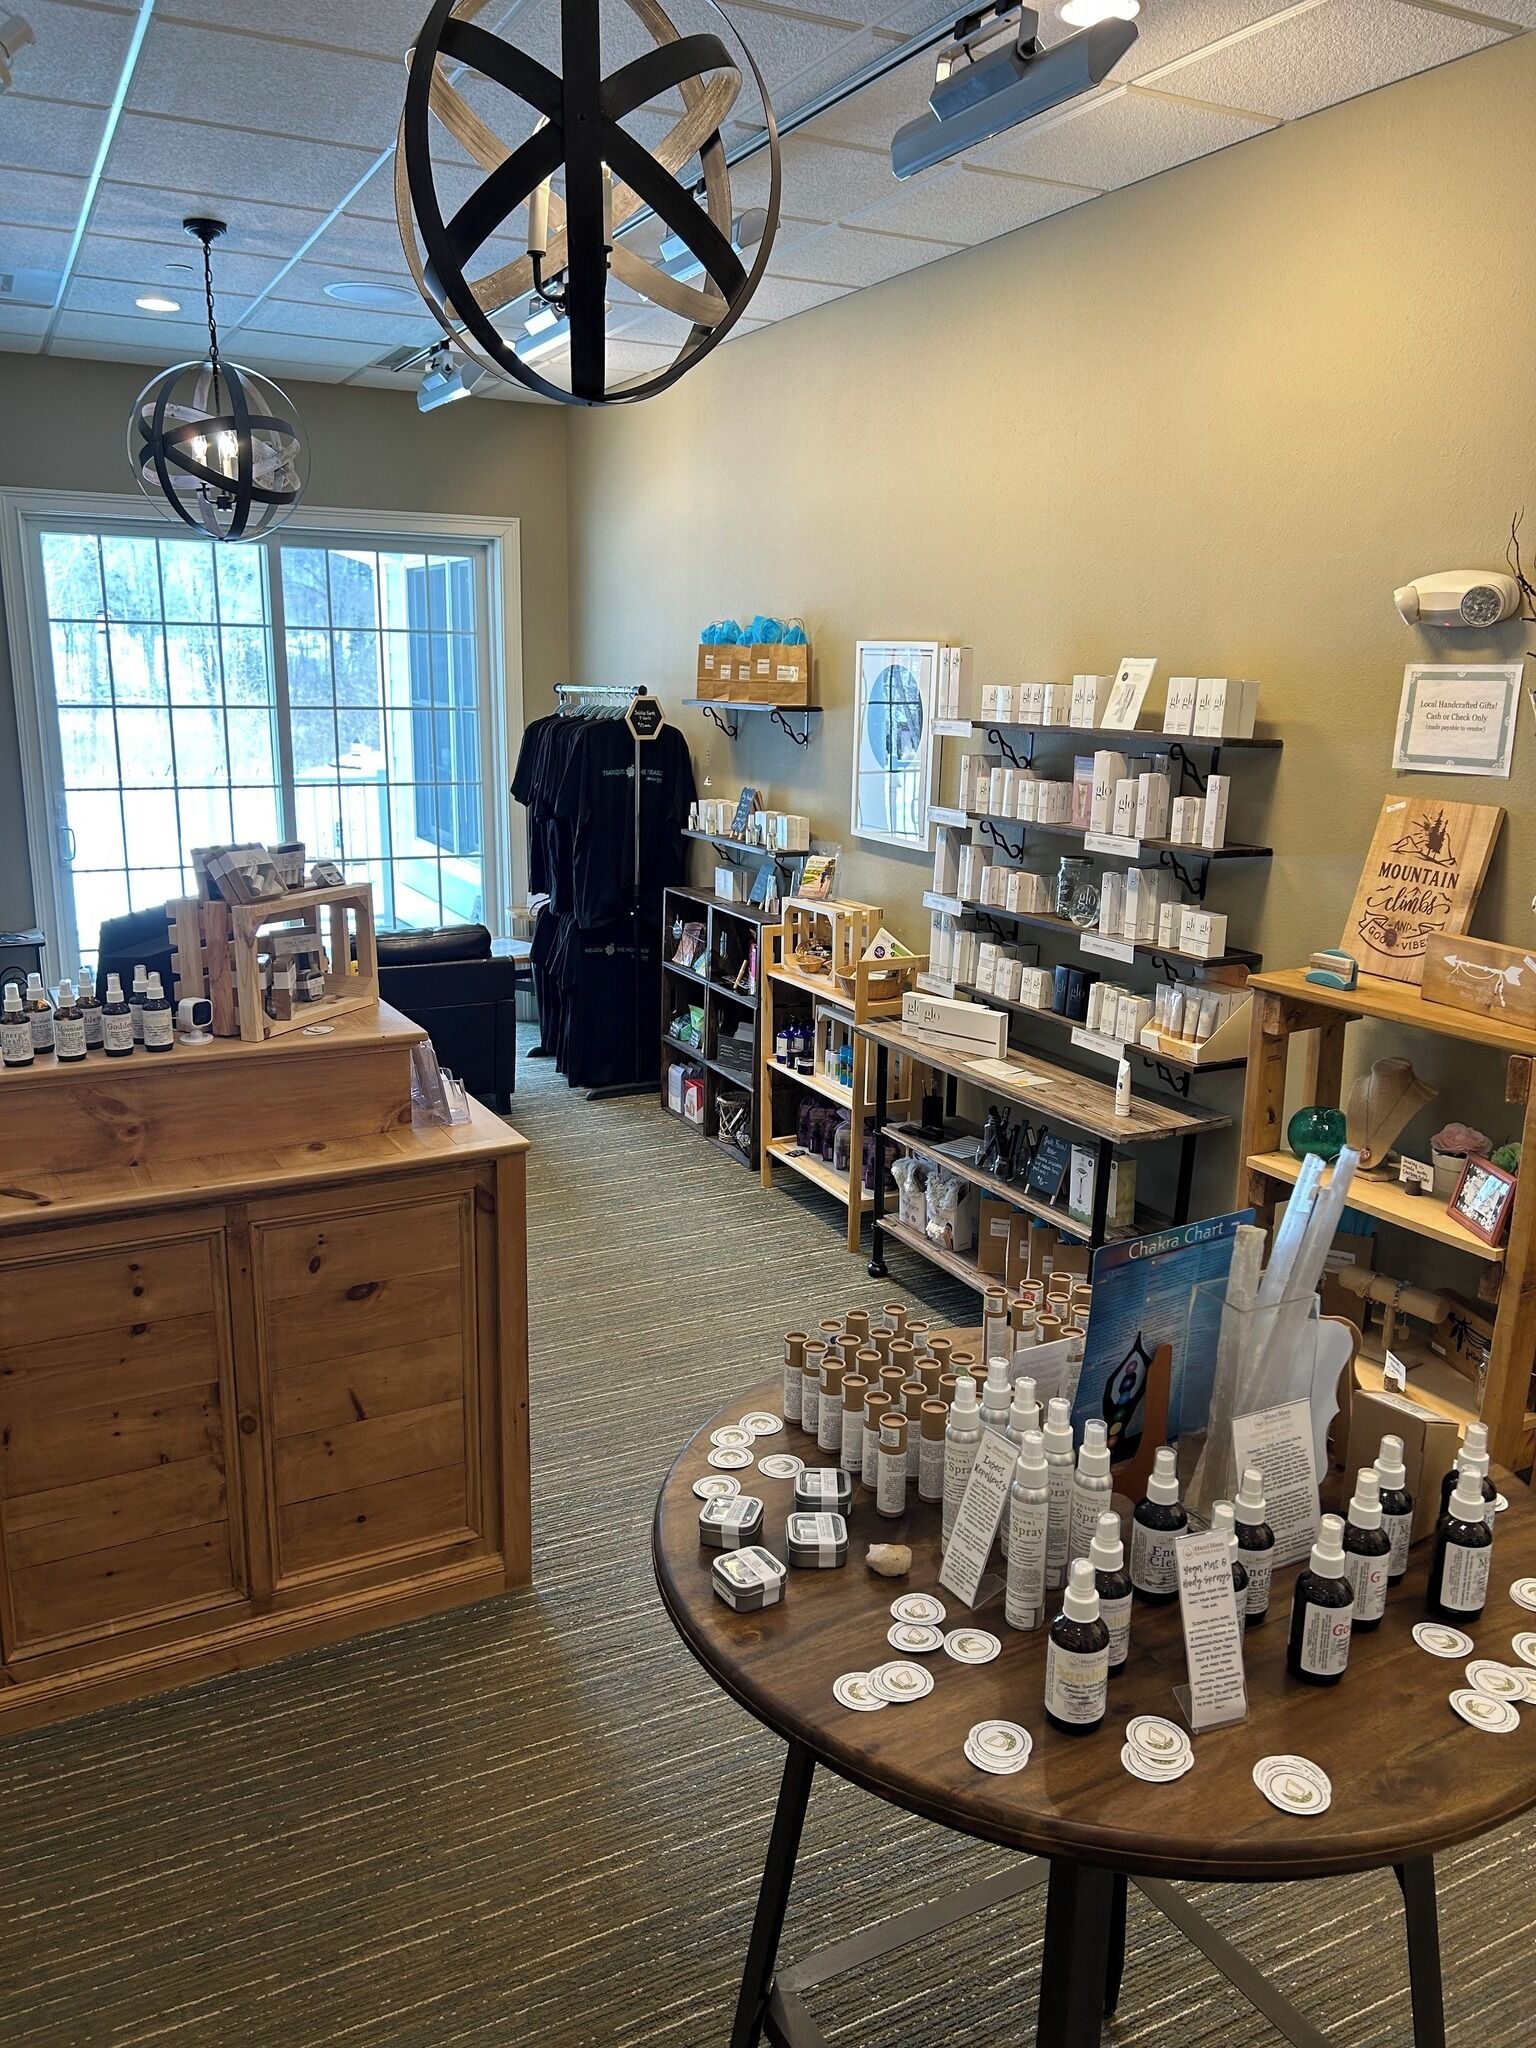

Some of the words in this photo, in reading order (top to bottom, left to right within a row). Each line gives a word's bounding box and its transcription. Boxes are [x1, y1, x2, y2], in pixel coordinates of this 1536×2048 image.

[1420, 700, 1437, 709] Local
[1438, 700, 1478, 710] Handcrafted
[1479, 701, 1498, 710] Gifts!
[1451, 713, 1470, 721] Check
[1472, 714, 1488, 723] Only
[1096, 781, 1112, 800] glo
[1118, 794, 1135, 814] glo
[1378, 862, 1460, 889] MOUNTAIN
[1377, 887, 1445, 915] climbs
[1394, 921, 1412, 933] AND
[1402, 940, 1428, 950] VIBE
[924, 1007, 940, 1022] glo
[1129, 1236, 1179, 1259] Chakra
[1185, 1222, 1223, 1243] Chart
[948, 1462, 971, 1476] Spra
[983, 1455, 1005, 1476] Insect
[1050, 1489, 1071, 1499] ray
[1077, 1509, 1098, 1524] Spr
[1012, 1522, 1043, 1539] Spray
[1204, 1559, 1219, 1571] Mat
